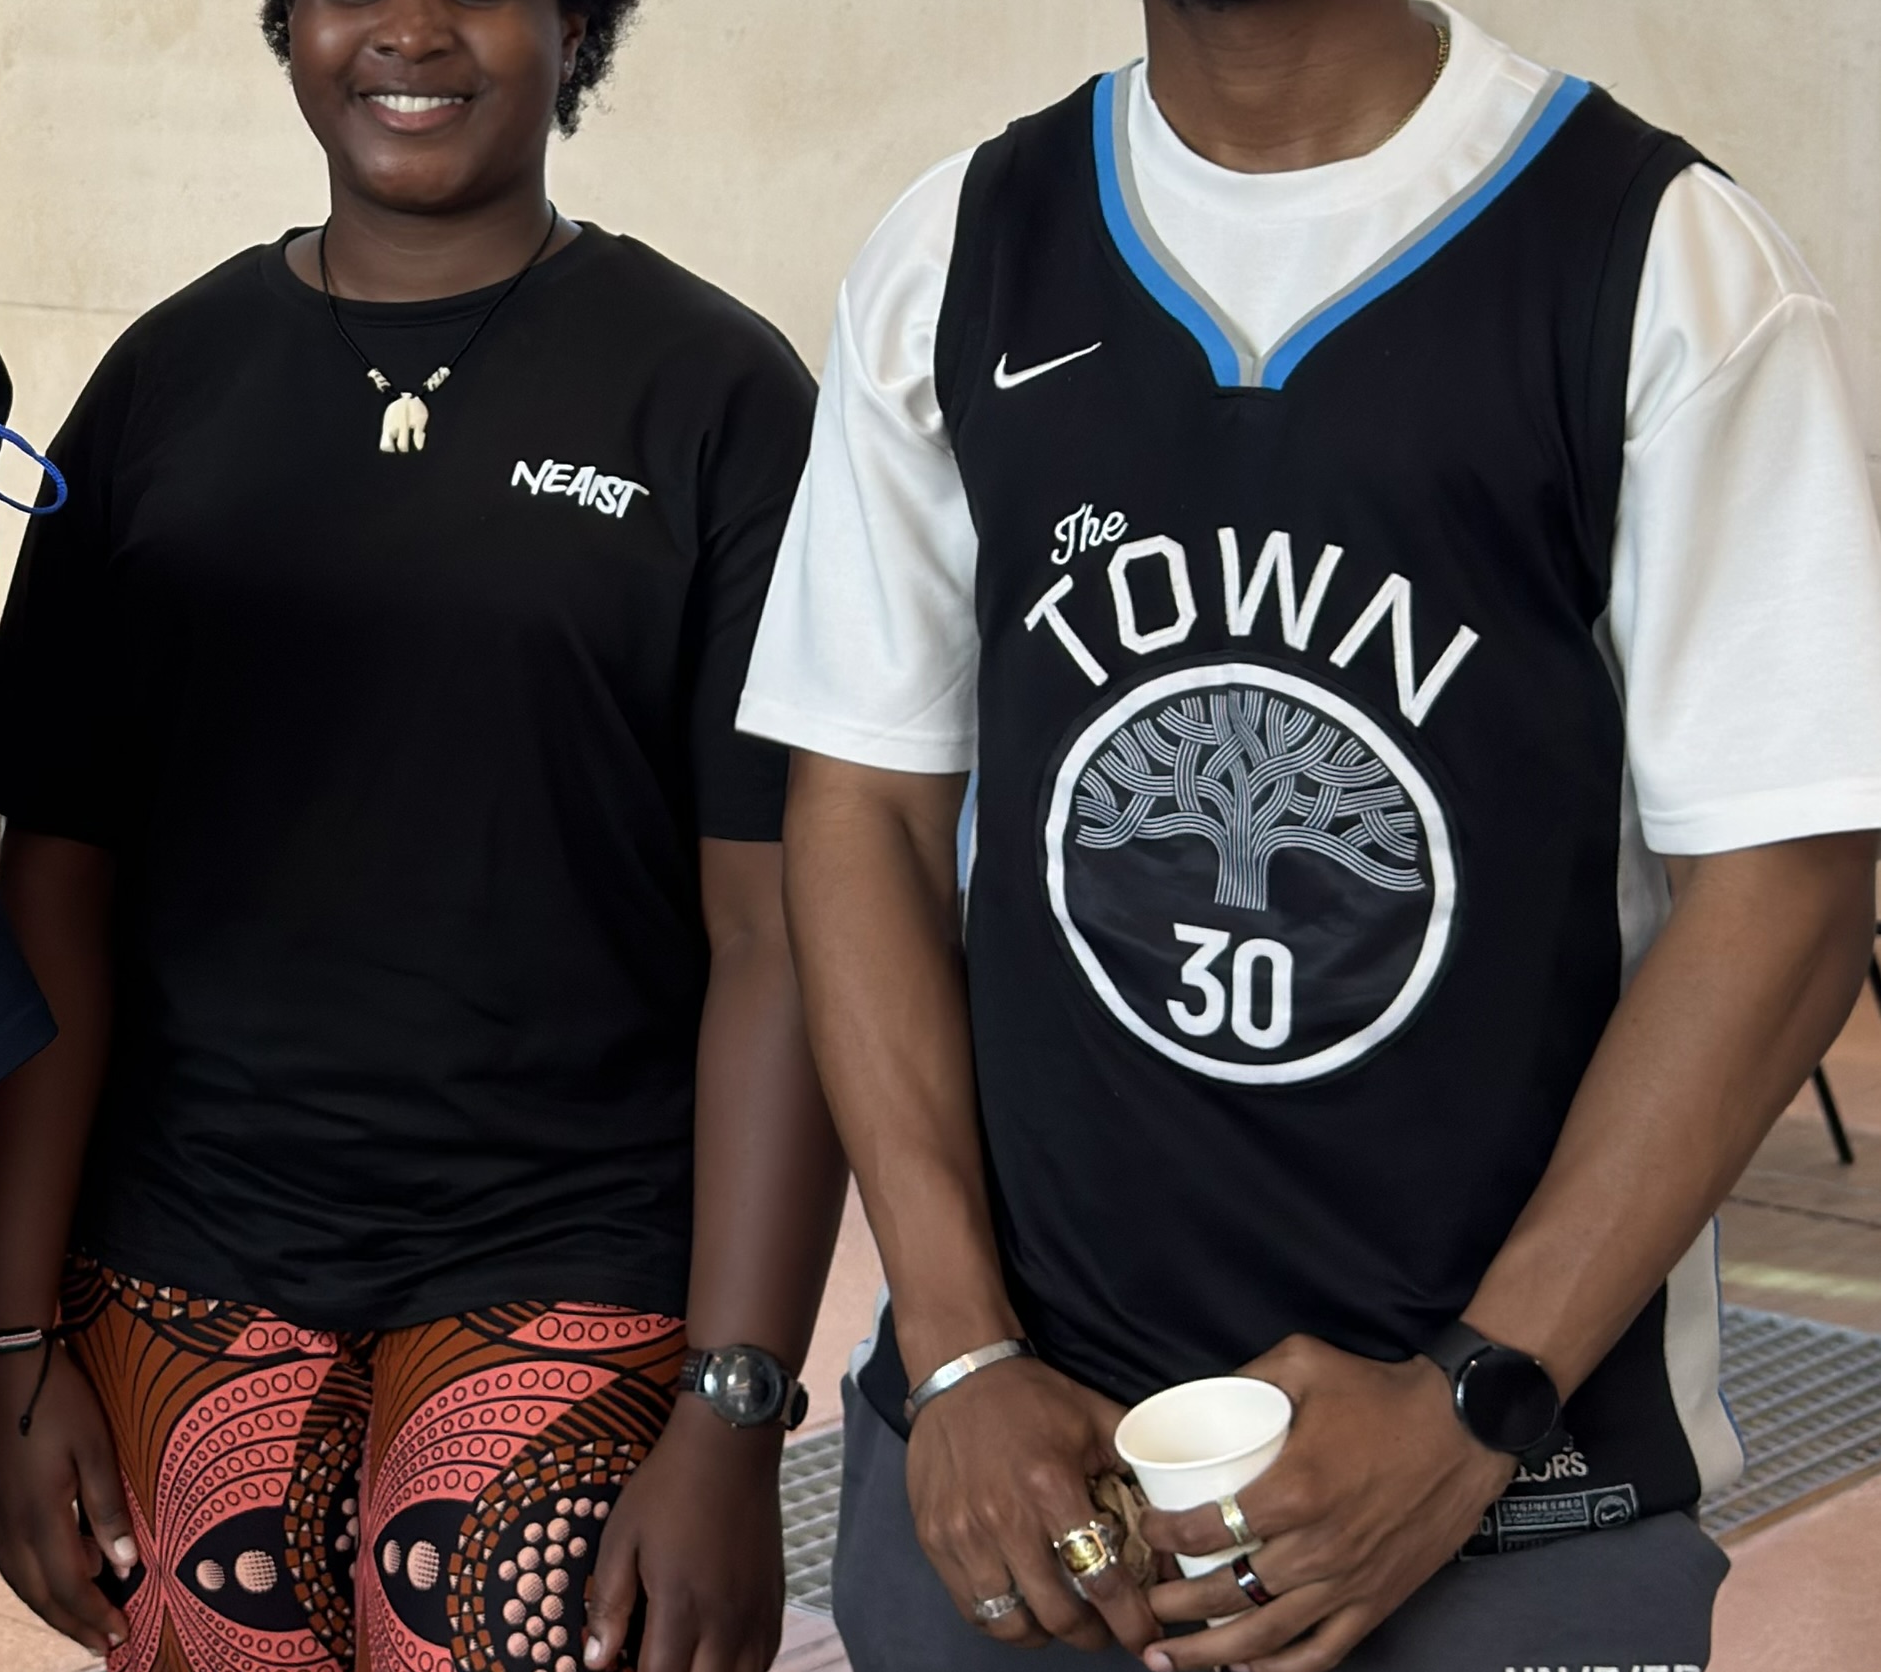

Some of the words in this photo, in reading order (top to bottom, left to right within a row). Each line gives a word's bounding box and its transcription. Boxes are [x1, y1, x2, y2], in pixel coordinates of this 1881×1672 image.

[1050, 502, 1128, 565] The
[1024, 526, 1480, 728] TOWN
[1166, 922, 1294, 1050] 30
